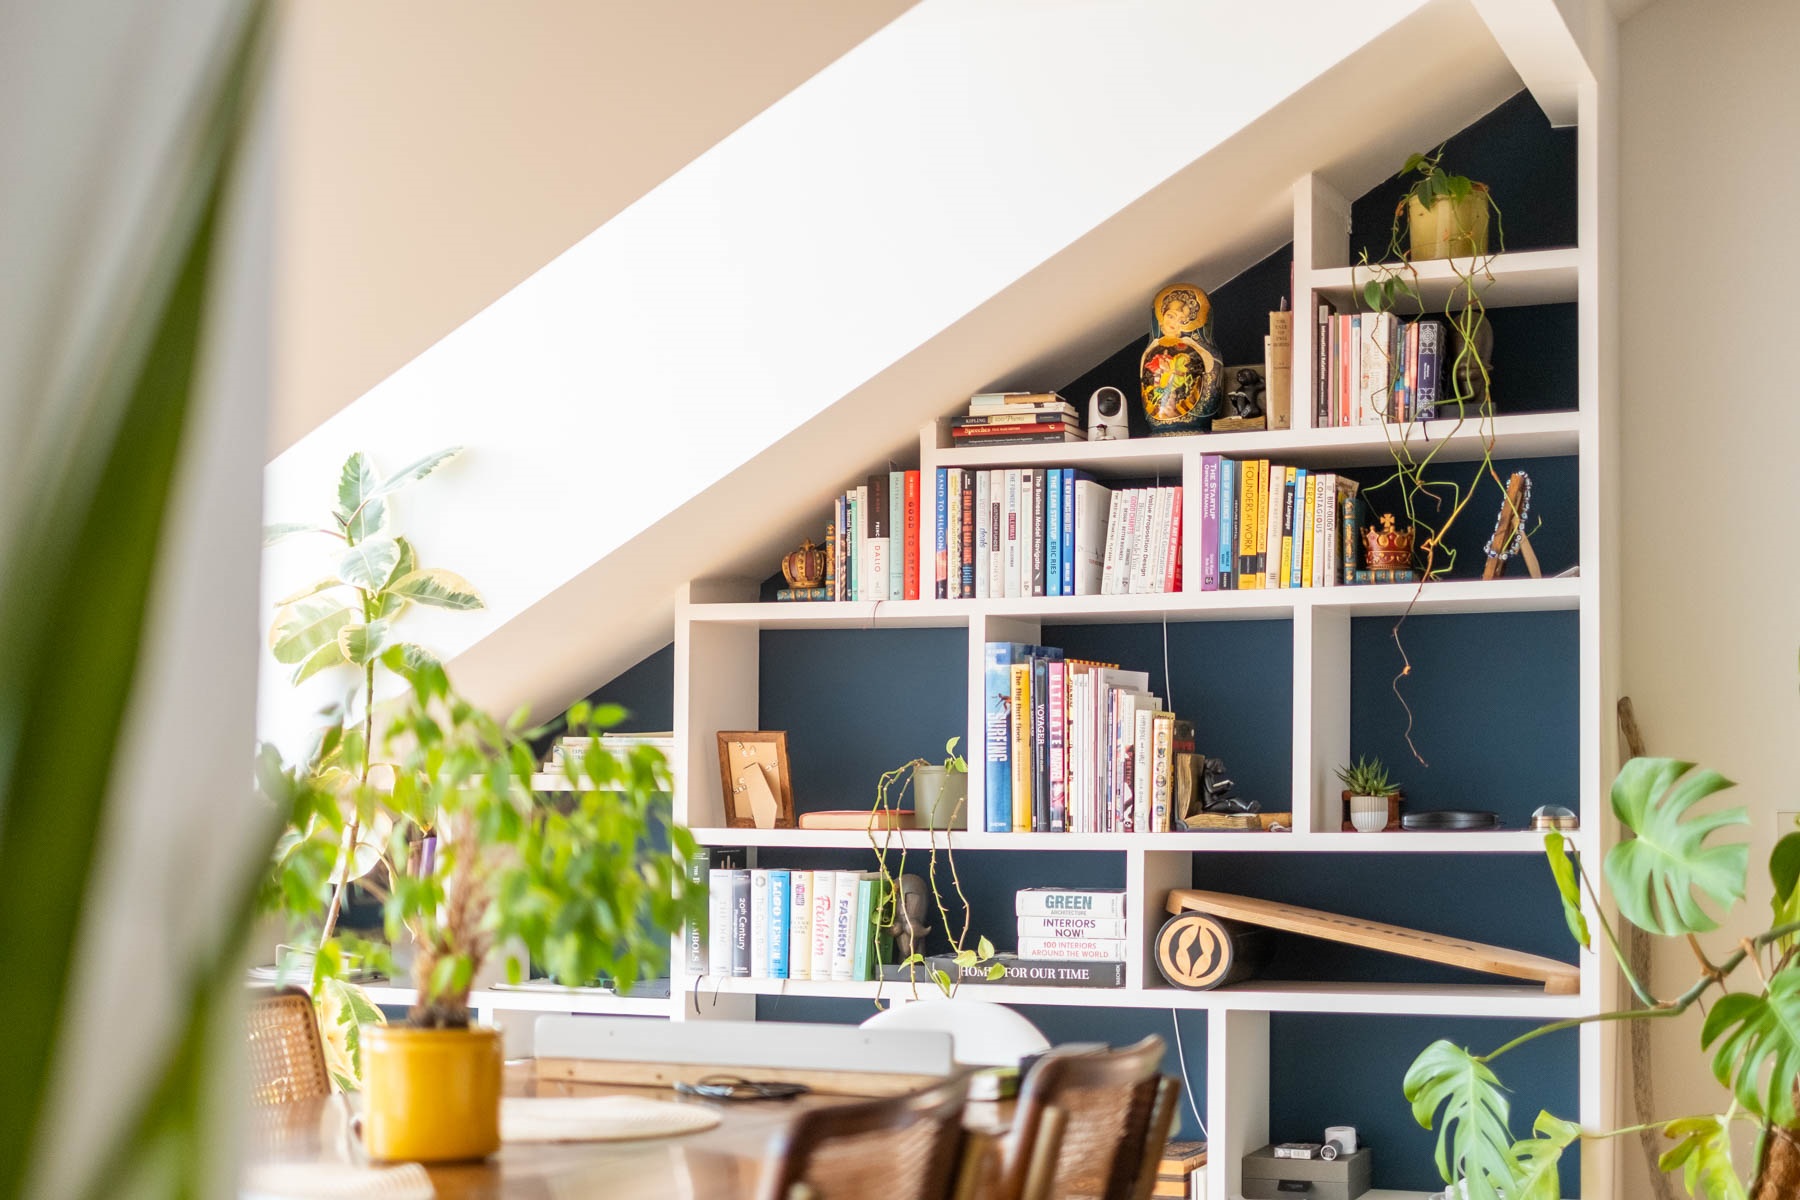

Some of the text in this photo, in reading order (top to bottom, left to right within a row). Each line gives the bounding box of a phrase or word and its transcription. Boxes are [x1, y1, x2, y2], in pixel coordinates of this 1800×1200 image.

[1209, 463, 1217, 520] THE STARTUP
[1245, 466, 1254, 512] FOUNDERS
[1260, 461, 1268, 493] EUROPEAN
[938, 500, 945, 512] TO
[1136, 502, 1144, 532] Business
[1165, 492, 1173, 518] Business
[1260, 494, 1268, 526] FOUNDERS
[1285, 505, 1293, 530] Language
[1316, 481, 1324, 534] CONTAGIOUS
[937, 517, 945, 549] SILICON
[979, 528, 988, 549] deals
[1127, 512, 1135, 535] CHARTS
[1143, 514, 1152, 552] Proposition
[1244, 524, 1254, 550] WORK
[908, 534, 914, 546] TO
[1033, 538, 1041, 570] Navigator
[1140, 554, 1149, 577] Design
[1159, 541, 1168, 575] Generation
[1014, 688, 1022, 701] Big
[1052, 674, 1062, 746] ULTIMATE
[987, 712, 1008, 762] SURFING
[1045, 895, 1092, 910] GREEN
[737, 897, 747, 950] 20th Century
[815, 896, 831, 956] Fashion
[837, 899, 849, 957] FASHION
[1043, 918, 1096, 928] INTERIORS
[1055, 929, 1084, 938] NOW!
[1043, 941, 1096, 949] 100 INTERIORS
[1004, 967, 1028, 978] FOR
[1030, 968, 1056, 979] OUR
[1057, 969, 1089, 980] TIME
